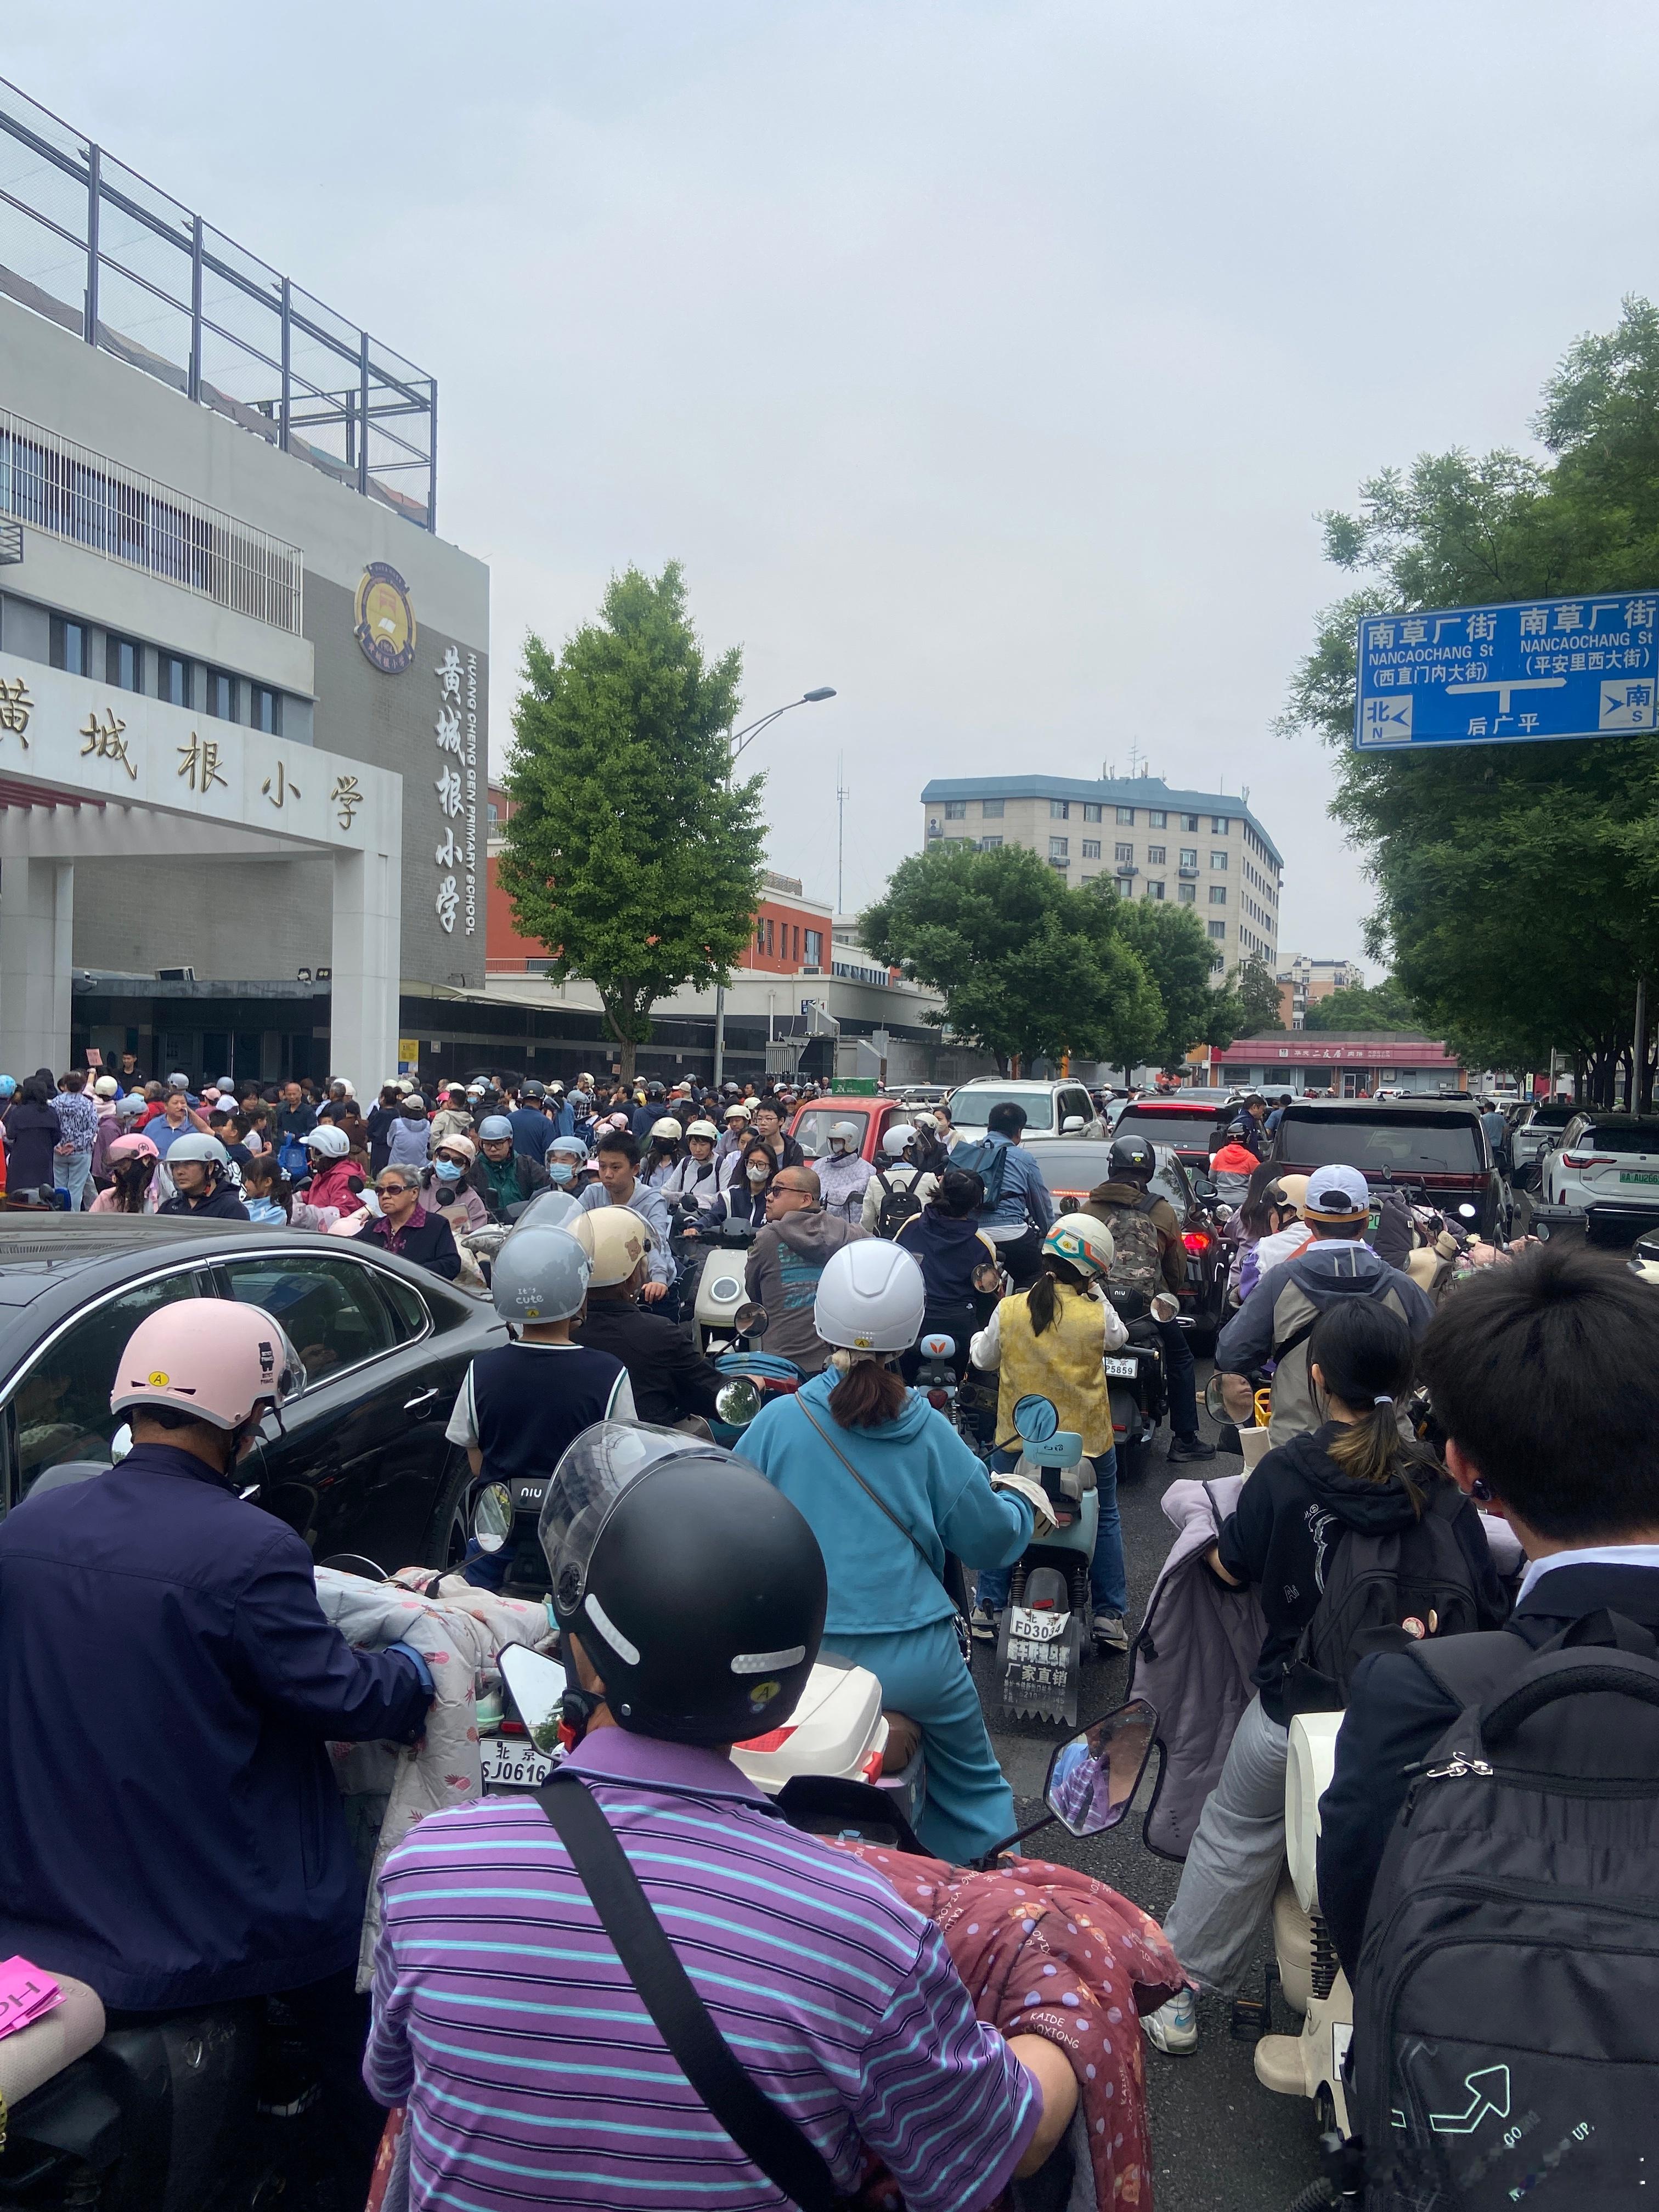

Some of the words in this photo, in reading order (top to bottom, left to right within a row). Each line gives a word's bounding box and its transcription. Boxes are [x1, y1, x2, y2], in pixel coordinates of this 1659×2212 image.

[1519, 599, 1657, 636] 南草厂街
[1368, 613, 1497, 651] 南草厂街
[1520, 632, 1630, 654] NANCAOCHANG
[1638, 630, 1653, 645] St
[1369, 645, 1472, 666] NANCAOCHANG
[1479, 644, 1494, 657] St
[1526, 647, 1650, 676] (平安里西大街)
[466, 653, 477, 710] HUANG
[1373, 661, 1487, 688] (西直门内大街)
[1626, 684, 1651, 708] 南
[1367, 701, 1390, 723] 北
[1632, 710, 1643, 722] S
[1372, 727, 1383, 738] N
[1466, 713, 1540, 736] 后广平
[466, 713, 477, 766] CHENG
[0, 677, 364, 830] 黄城根小学
[434, 645, 466, 933] 黄城根小学
[466, 769, 476, 802] GEN
[465, 804, 476, 872] PRIMARY
[465, 874, 476, 936] SCHOOL
[516, 1295, 544, 1304] cute
[154, 1374, 162, 1384] A
[1015, 1620, 1062, 1639] FD3034
[1026, 1613, 1060, 1627] 北京
[1005, 1662, 1069, 1688] 厂家直销
[757, 1685, 769, 1700] A
[496, 1746, 535, 1761] 北京
[482, 1760, 546, 1782] SJ0616
[943, 1907, 964, 1936] KAID
[1030, 2012, 1066, 2028] KAIDE
